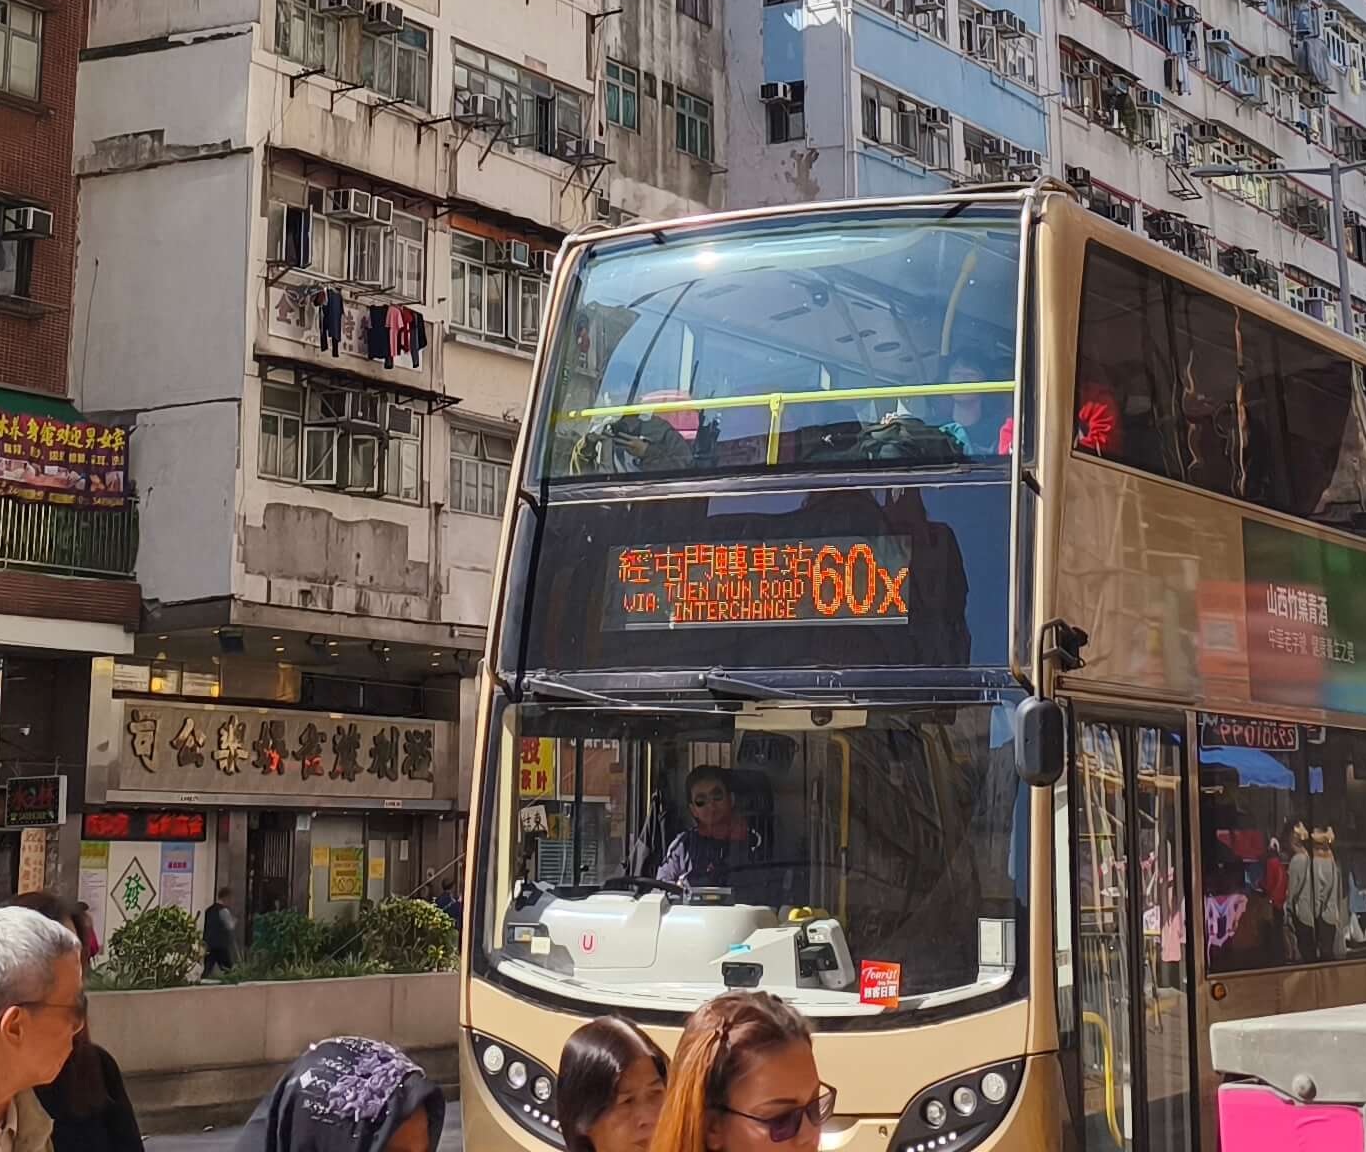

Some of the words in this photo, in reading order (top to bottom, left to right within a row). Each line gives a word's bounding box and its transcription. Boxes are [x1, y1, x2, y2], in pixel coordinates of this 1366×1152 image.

[618, 541, 813, 583] 經屯門轉車站
[664, 580, 709, 601] TUEN
[718, 579, 753, 601] MUN
[759, 578, 805, 600] ROAD
[673, 598, 797, 623] INTERCHANGE
[862, 966, 898, 983] Tourist
